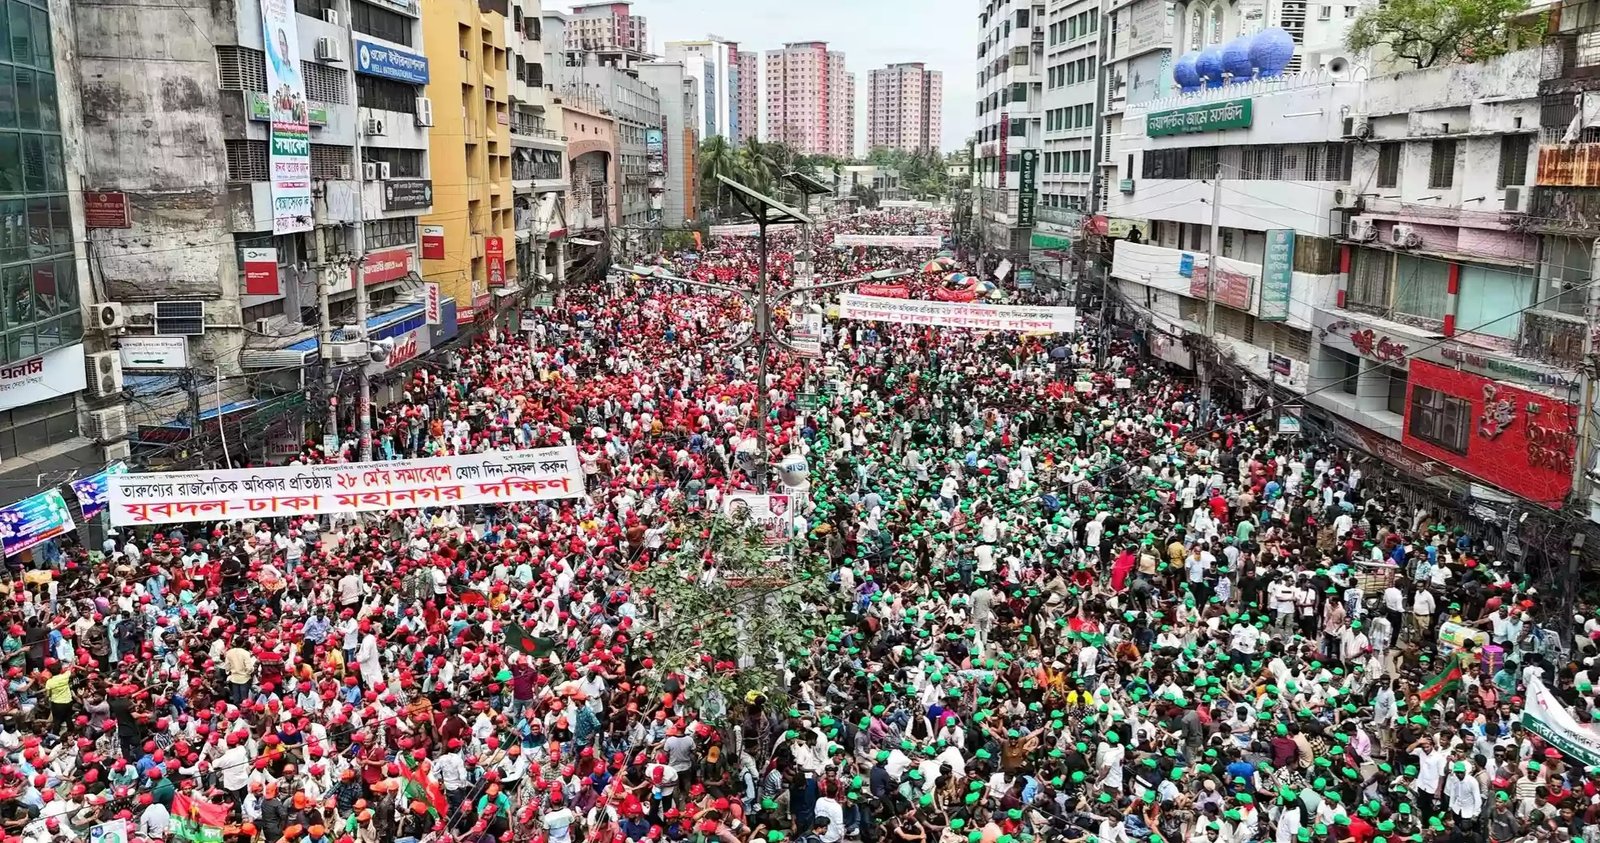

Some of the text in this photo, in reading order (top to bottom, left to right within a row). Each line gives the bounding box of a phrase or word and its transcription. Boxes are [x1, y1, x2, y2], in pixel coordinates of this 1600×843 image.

[371, 64, 413, 79] WELL INTERNATIONAL
[1149, 102, 1244, 130] নয়াপল্টন জামে মসজিদ
[273, 138, 308, 154] সমাবেশ
[428, 284, 437, 322] Bata
[386, 340, 417, 369] Bata
[120, 484, 173, 498] তারুণ্যের
[177, 478, 238, 496] রাজনৈতিক
[242, 476, 285, 492] অধিকার
[290, 472, 332, 490] প্রতিষ্ঠায়
[337, 472, 356, 490] ২৮
[396, 464, 452, 485] সমাবেশে
[456, 464, 480, 480] যোগ
[482, 460, 536, 478] দিন-সফল
[540, 459, 568, 474] করুন
[122, 495, 323, 522] যুবদল-ঢাকা
[333, 486, 465, 508] মহানগর
[475, 476, 572, 498] দক্ষিণ
